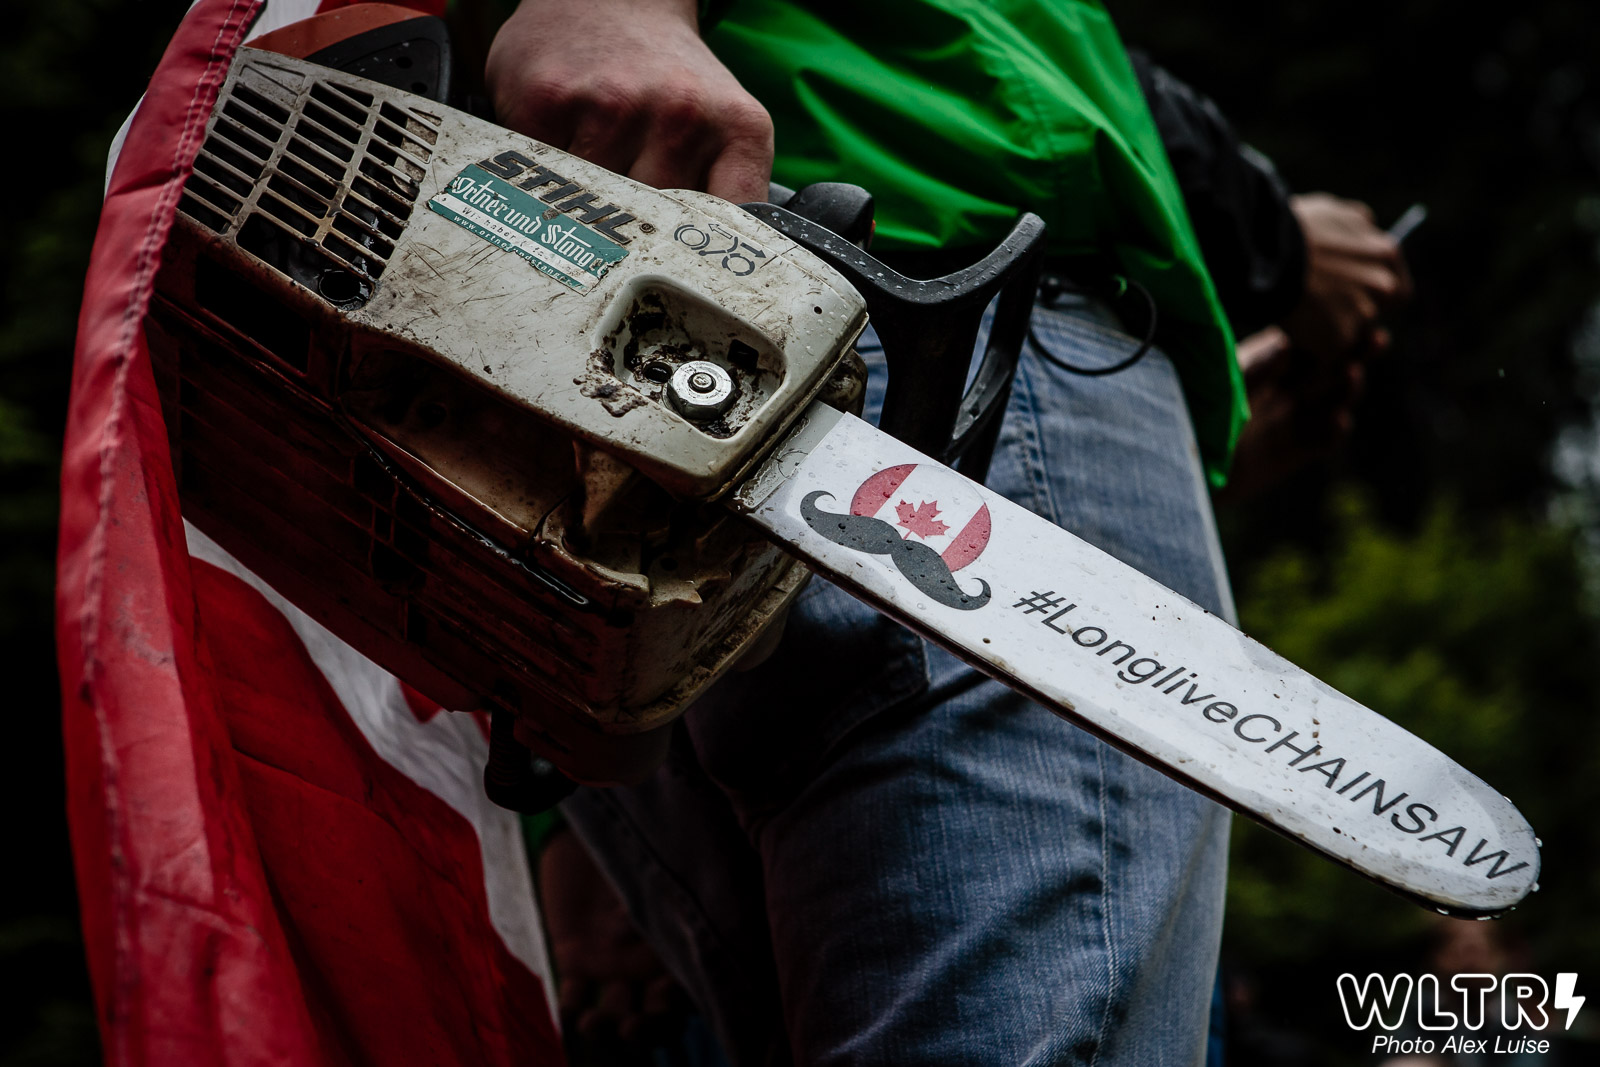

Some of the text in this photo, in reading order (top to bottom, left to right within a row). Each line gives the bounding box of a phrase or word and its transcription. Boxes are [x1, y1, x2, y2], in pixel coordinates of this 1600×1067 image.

[452, 177, 509, 217] Ortner
[504, 209, 542, 235] und
[476, 150, 637, 245] STIHL
[1012, 589, 1530, 880] #LongliveCHAINSAW
